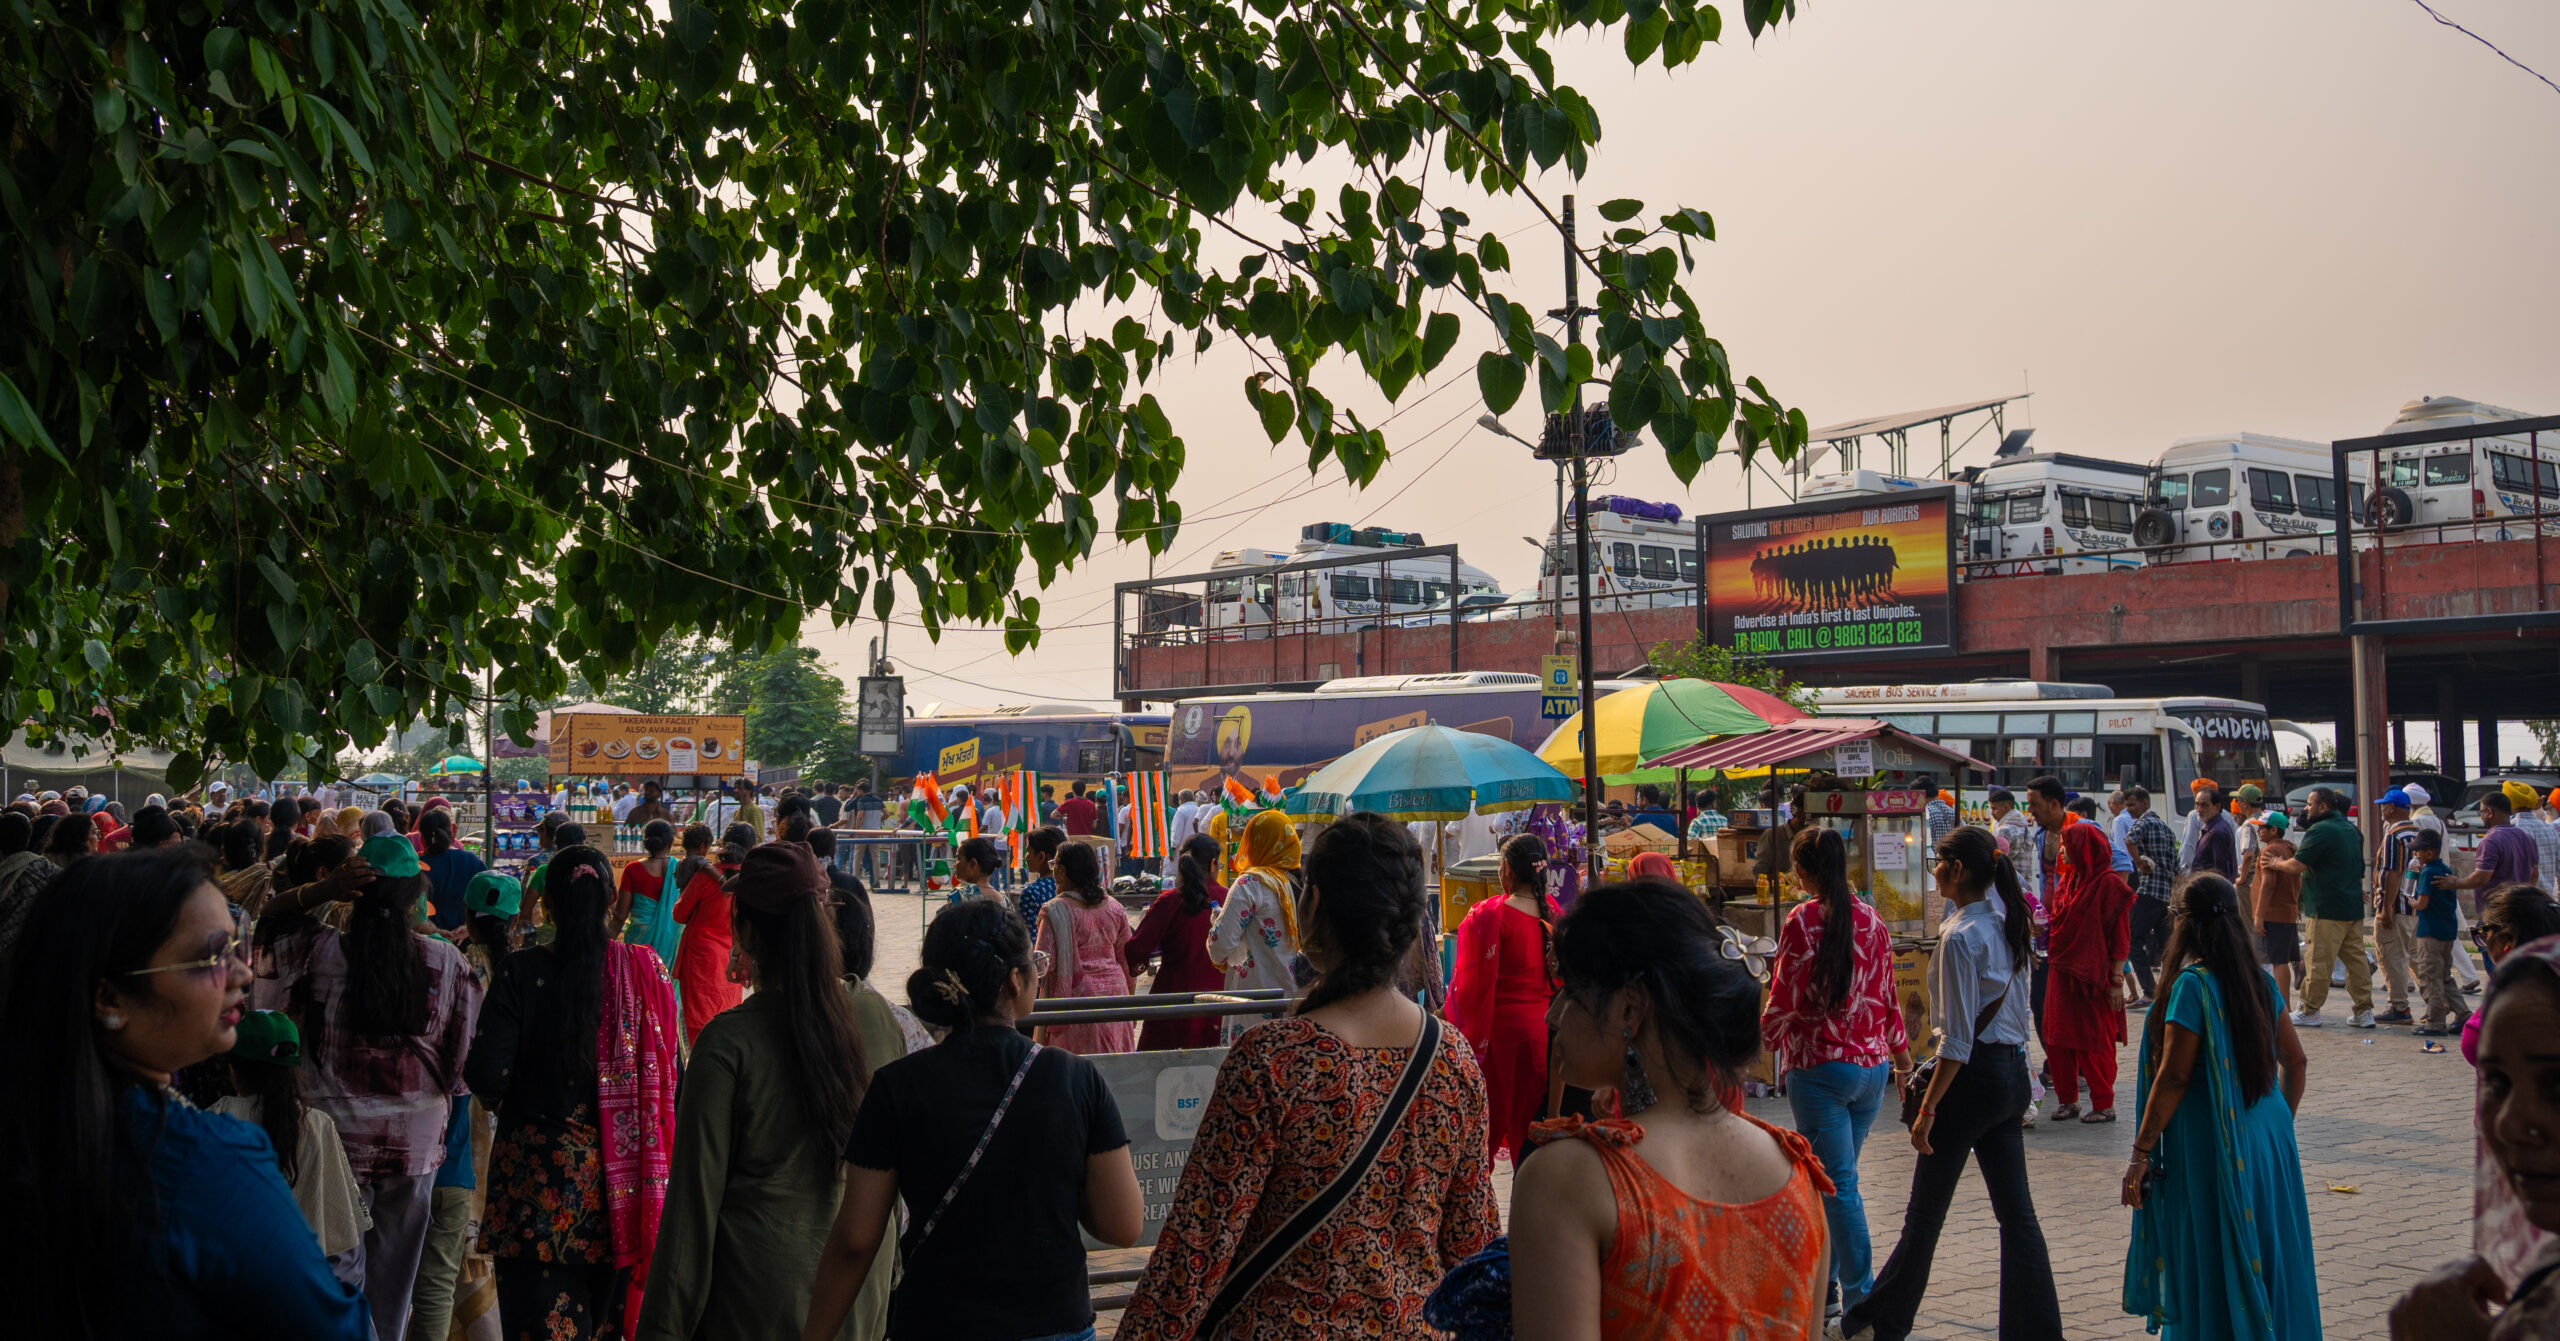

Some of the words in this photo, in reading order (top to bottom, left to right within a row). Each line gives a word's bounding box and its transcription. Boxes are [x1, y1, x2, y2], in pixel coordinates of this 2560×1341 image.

[2512, 494, 2560, 511] TRAVLLER
[1732, 522, 1767, 540] SALUTING
[1768, 520, 1782, 536] THE
[1784, 516, 1812, 534] HEROES
[1814, 514, 1832, 531] WHO
[1834, 511, 1861, 529] GUARD
[1863, 508, 1879, 526] OUR
[1881, 505, 1919, 524] BORDERS
[1347, 601, 1389, 610] TRAVELL
[1734, 613, 1776, 629] Advertise
[1779, 612, 1787, 626] at
[1789, 610, 1819, 625] India's
[1821, 608, 1842, 623] first
[1844, 608, 1851, 621] &
[1853, 606, 1871, 620] last
[1750, 630, 1784, 653] BOOK,
[1787, 628, 1814, 649] CALL
[1816, 626, 1832, 648] @
[1834, 624, 1865, 647] 9803
[1869, 622, 1893, 645] 823
[1896, 620, 1922, 643] 823
[1886, 687, 1903, 698] BUS
[1906, 687, 1937, 697] SERVICE
[1544, 699, 1578, 715] ATM
[618, 717, 664, 725] TAKEAWAY
[2108, 717, 2134, 729] PILOT
[625, 726, 647, 734] ALSO
[648, 726, 693, 734] AVAILABLE
[1388, 792, 1432, 809] Bisleri
[1902, 978, 1920, 987] From
[1177, 1097, 1200, 1109] BSF
